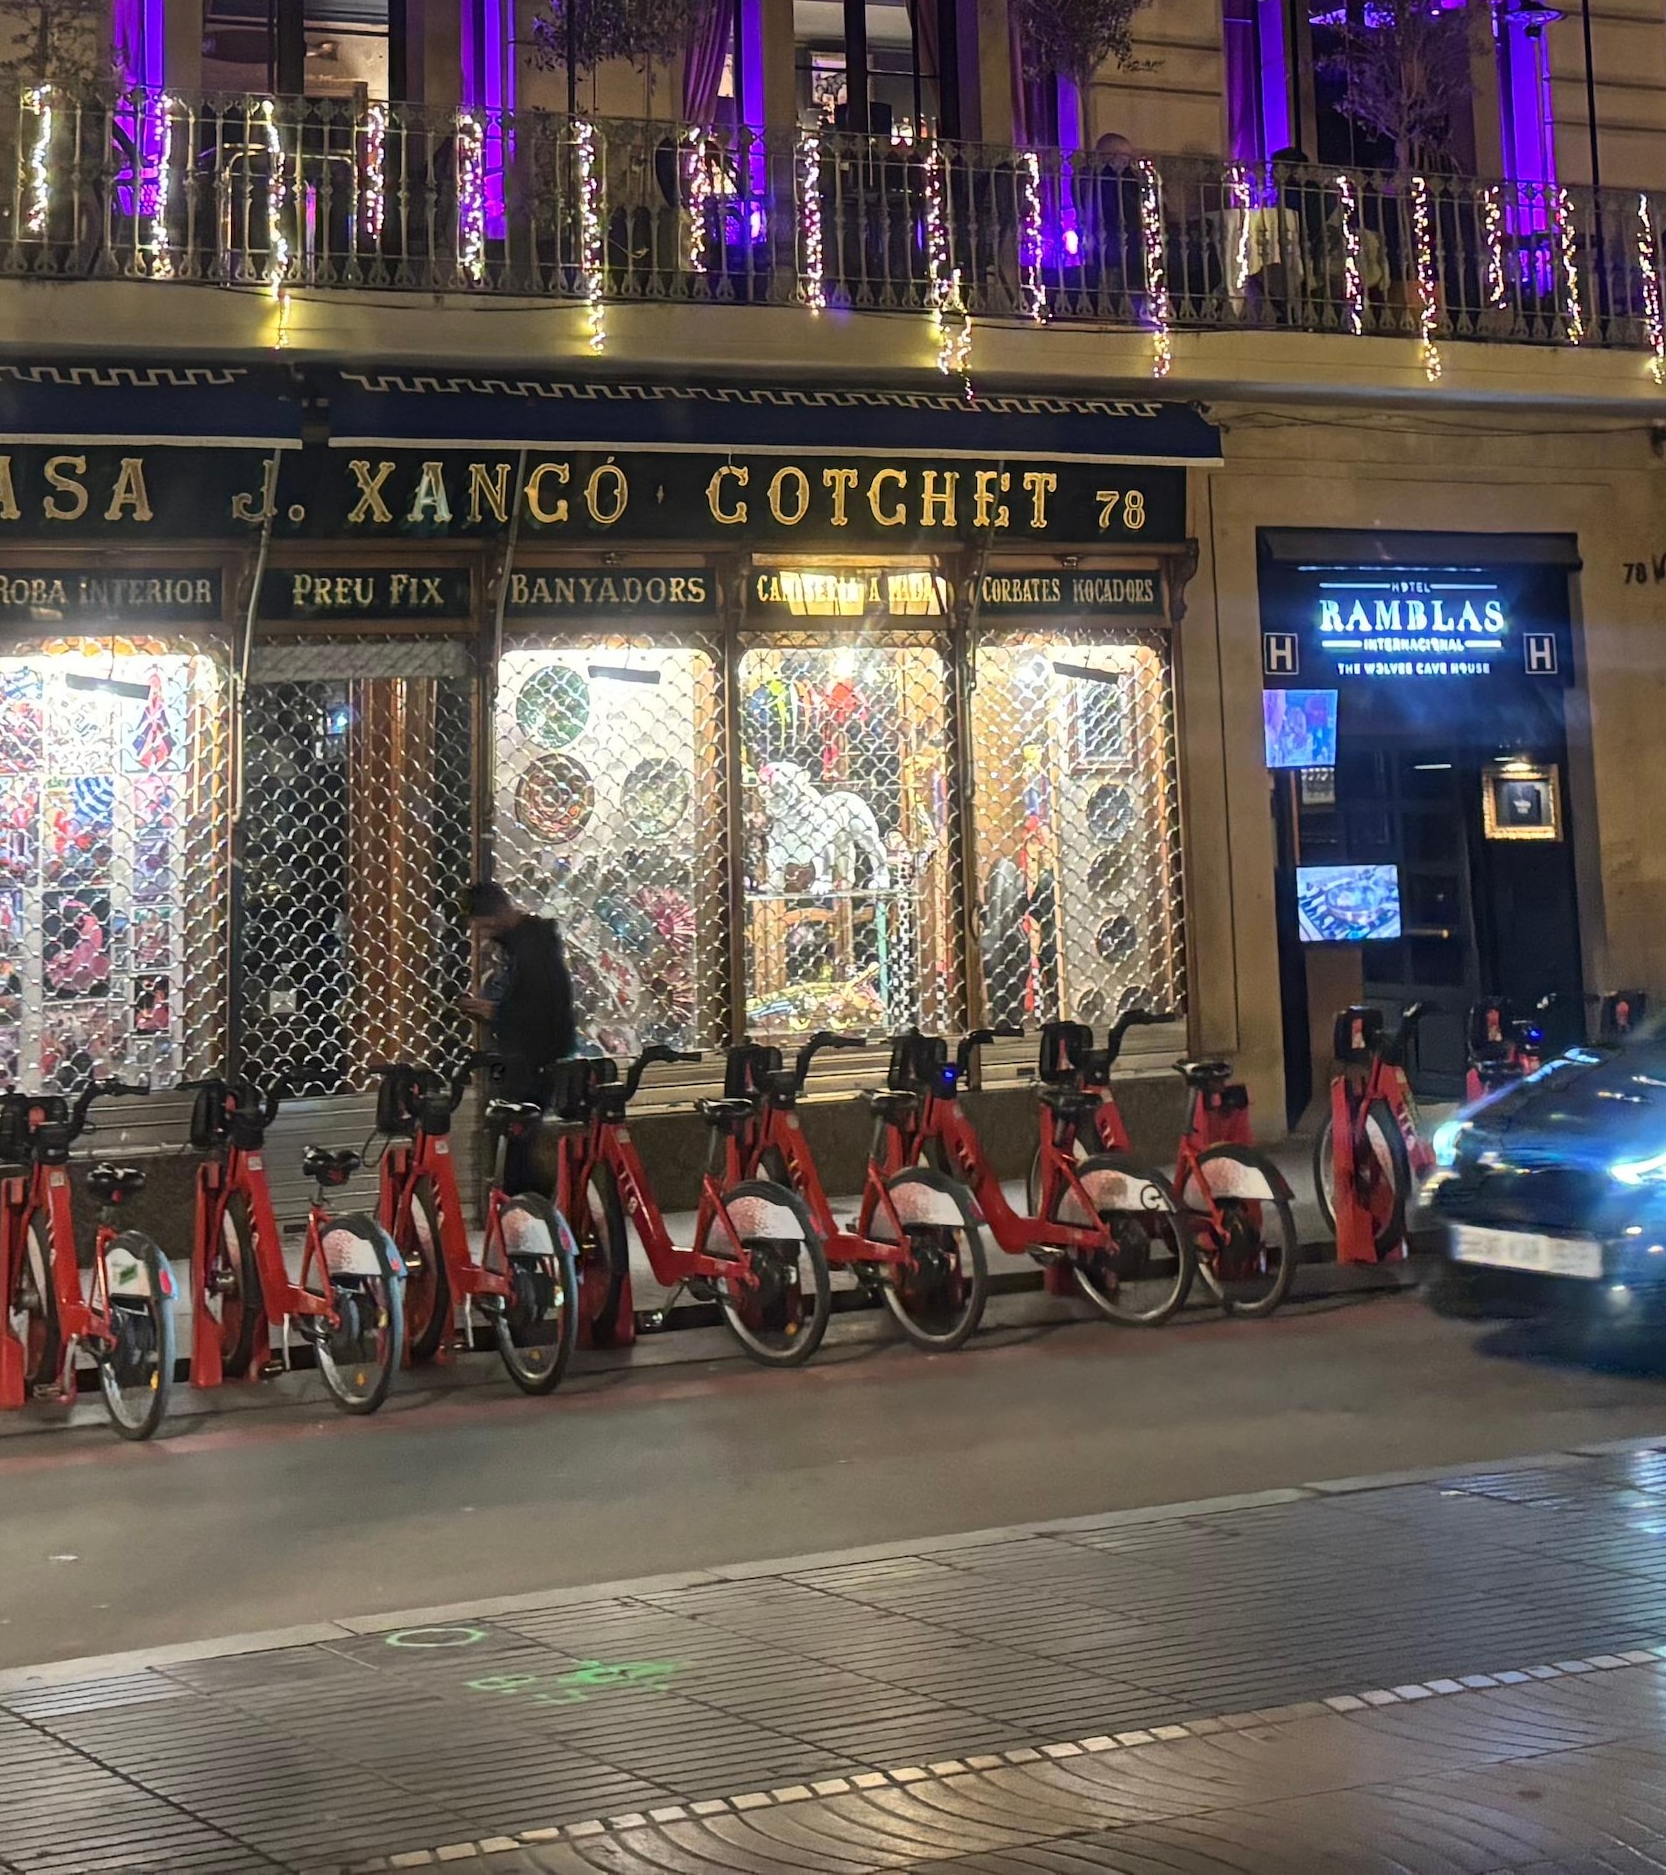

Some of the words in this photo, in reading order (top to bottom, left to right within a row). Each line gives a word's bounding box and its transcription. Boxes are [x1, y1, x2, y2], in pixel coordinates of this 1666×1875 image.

[232, 459, 305, 522] J.
[705, 465, 1057, 527] COTCHET
[1096, 490, 1146, 530] 78
[79, 578, 213, 606] INTERIOR
[292, 574, 375, 606] PREU
[389, 573, 445, 605] FIX
[510, 574, 707, 605] BANYADORS
[757, 574, 863, 603] CAMISER
[869, 577, 881, 602] A
[982, 575, 1061, 604] CORBATES
[1072, 577, 1154, 604] MOCADORS
[1391, 582, 1431, 593] HOTEL
[1319, 599, 1504, 633] RAMBLAS
[1270, 637, 1293, 671] H
[1364, 638, 1465, 652] INTERNACIONAL
[1530, 638, 1552, 670] H
[1338, 664, 1360, 675] THE
[1364, 663, 1413, 675] WOLVES
[1416, 663, 1447, 675] CAVE
[1450, 663, 1490, 674] HOUSE
